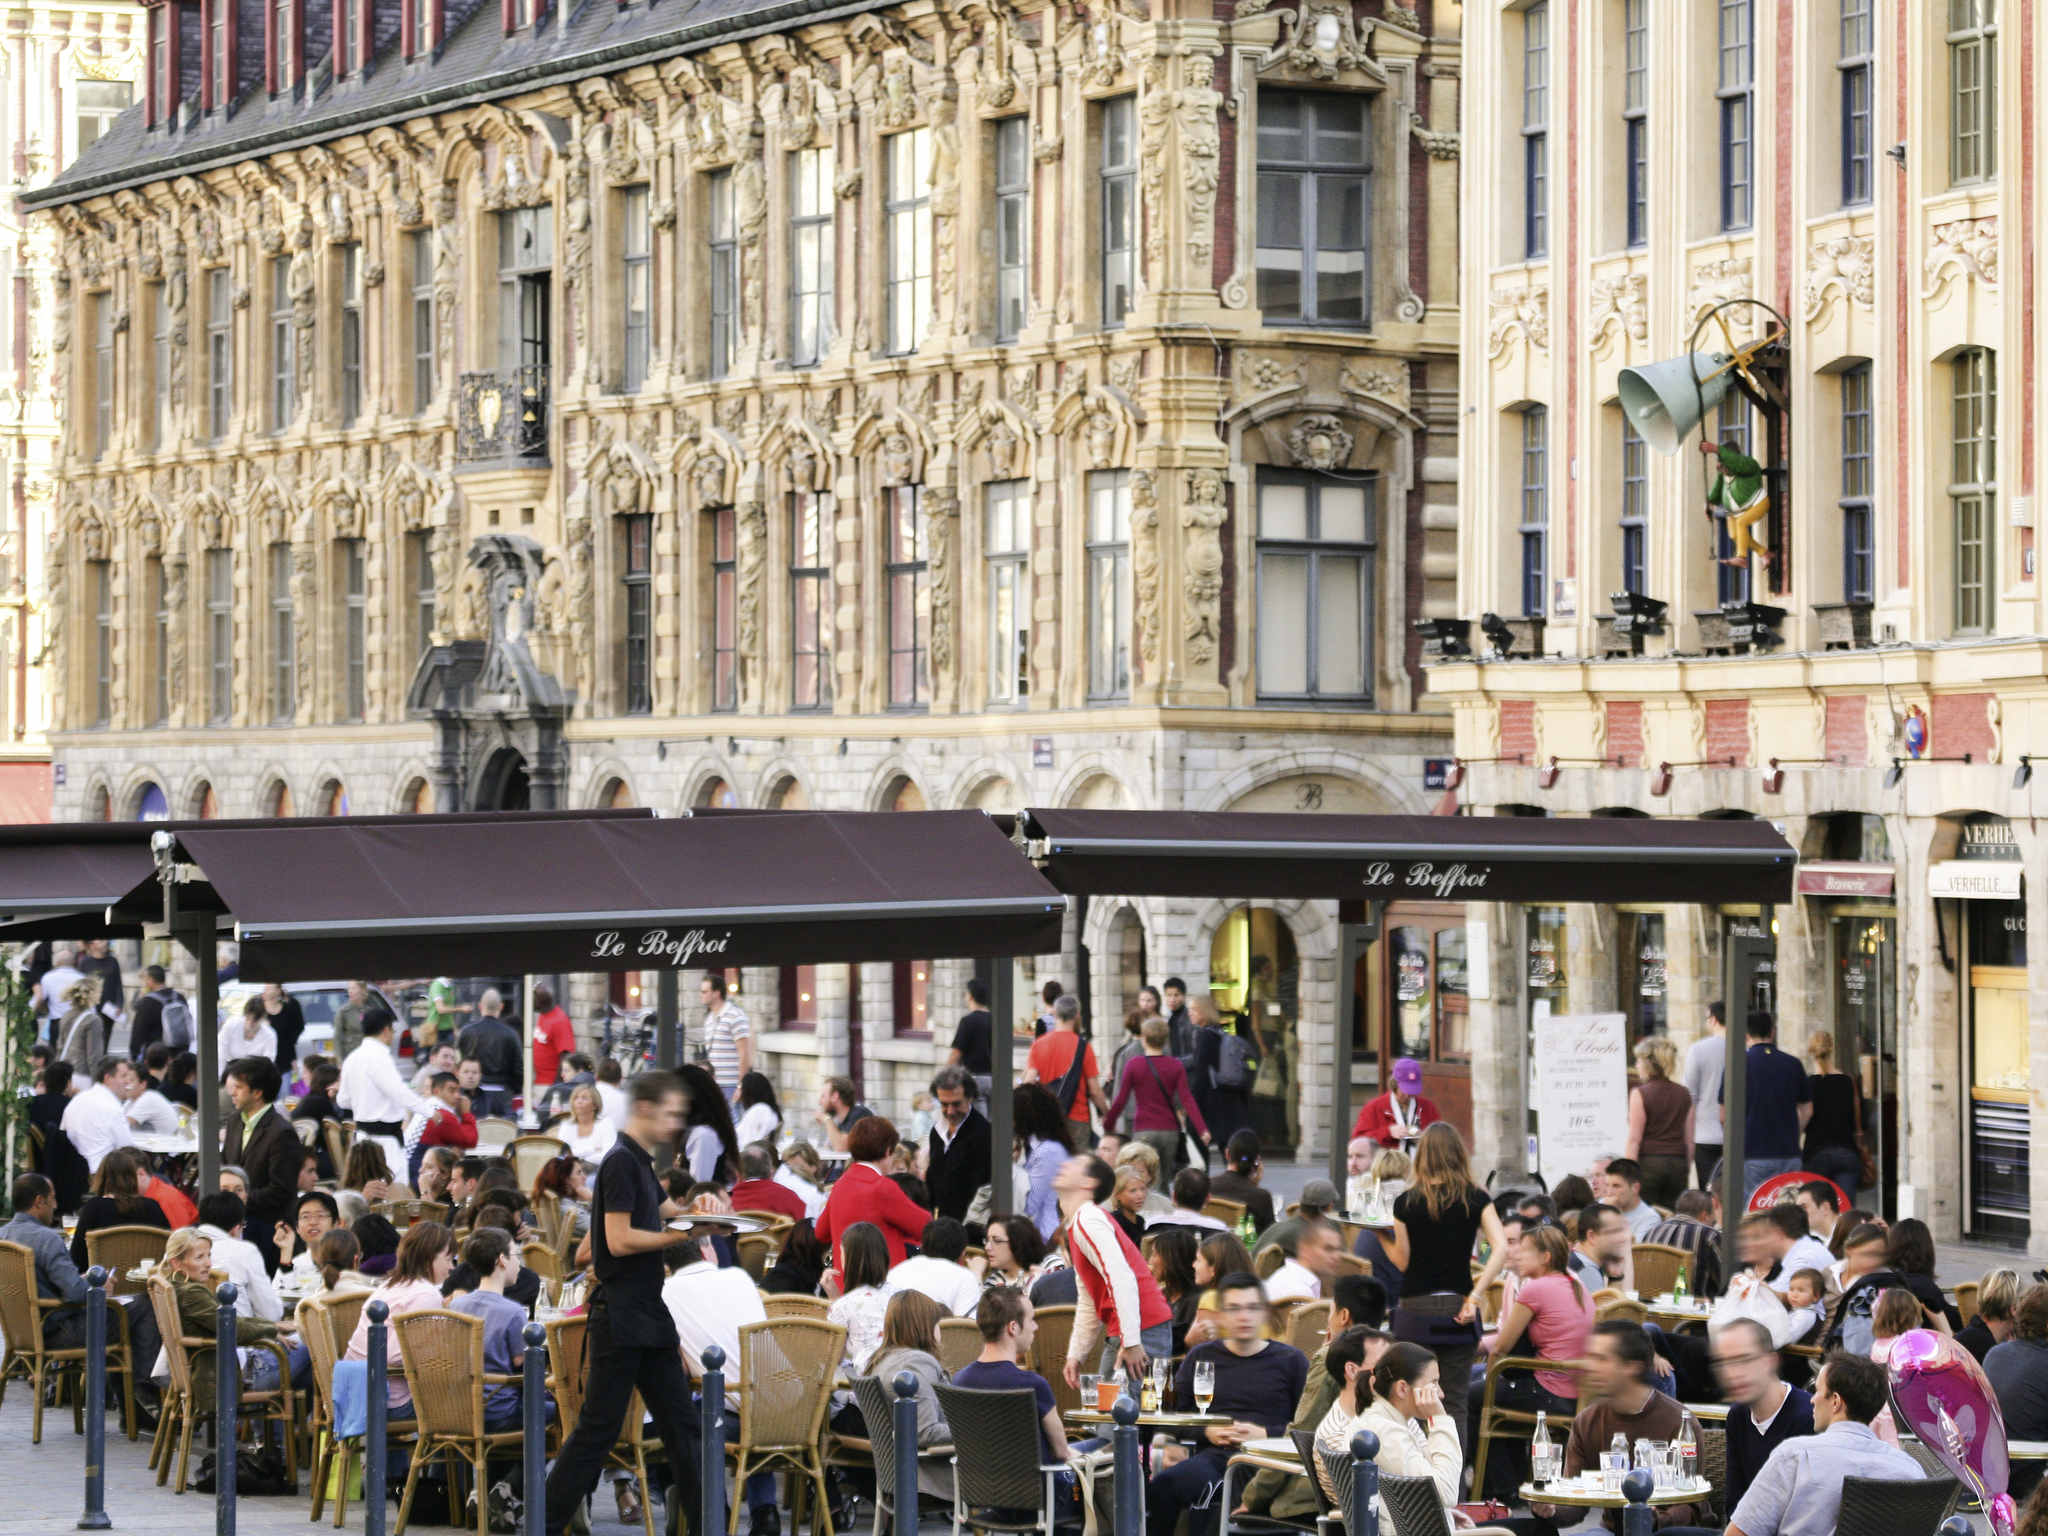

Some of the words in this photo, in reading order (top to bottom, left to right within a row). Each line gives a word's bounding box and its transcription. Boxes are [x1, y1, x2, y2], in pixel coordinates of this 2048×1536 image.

[1363, 862, 1394, 886] Le
[1405, 862, 1491, 897] Beffroi
[1949, 876, 2001, 893] VERHELLE
[591, 931, 625, 957] Le
[637, 929, 732, 965] Beffroi
